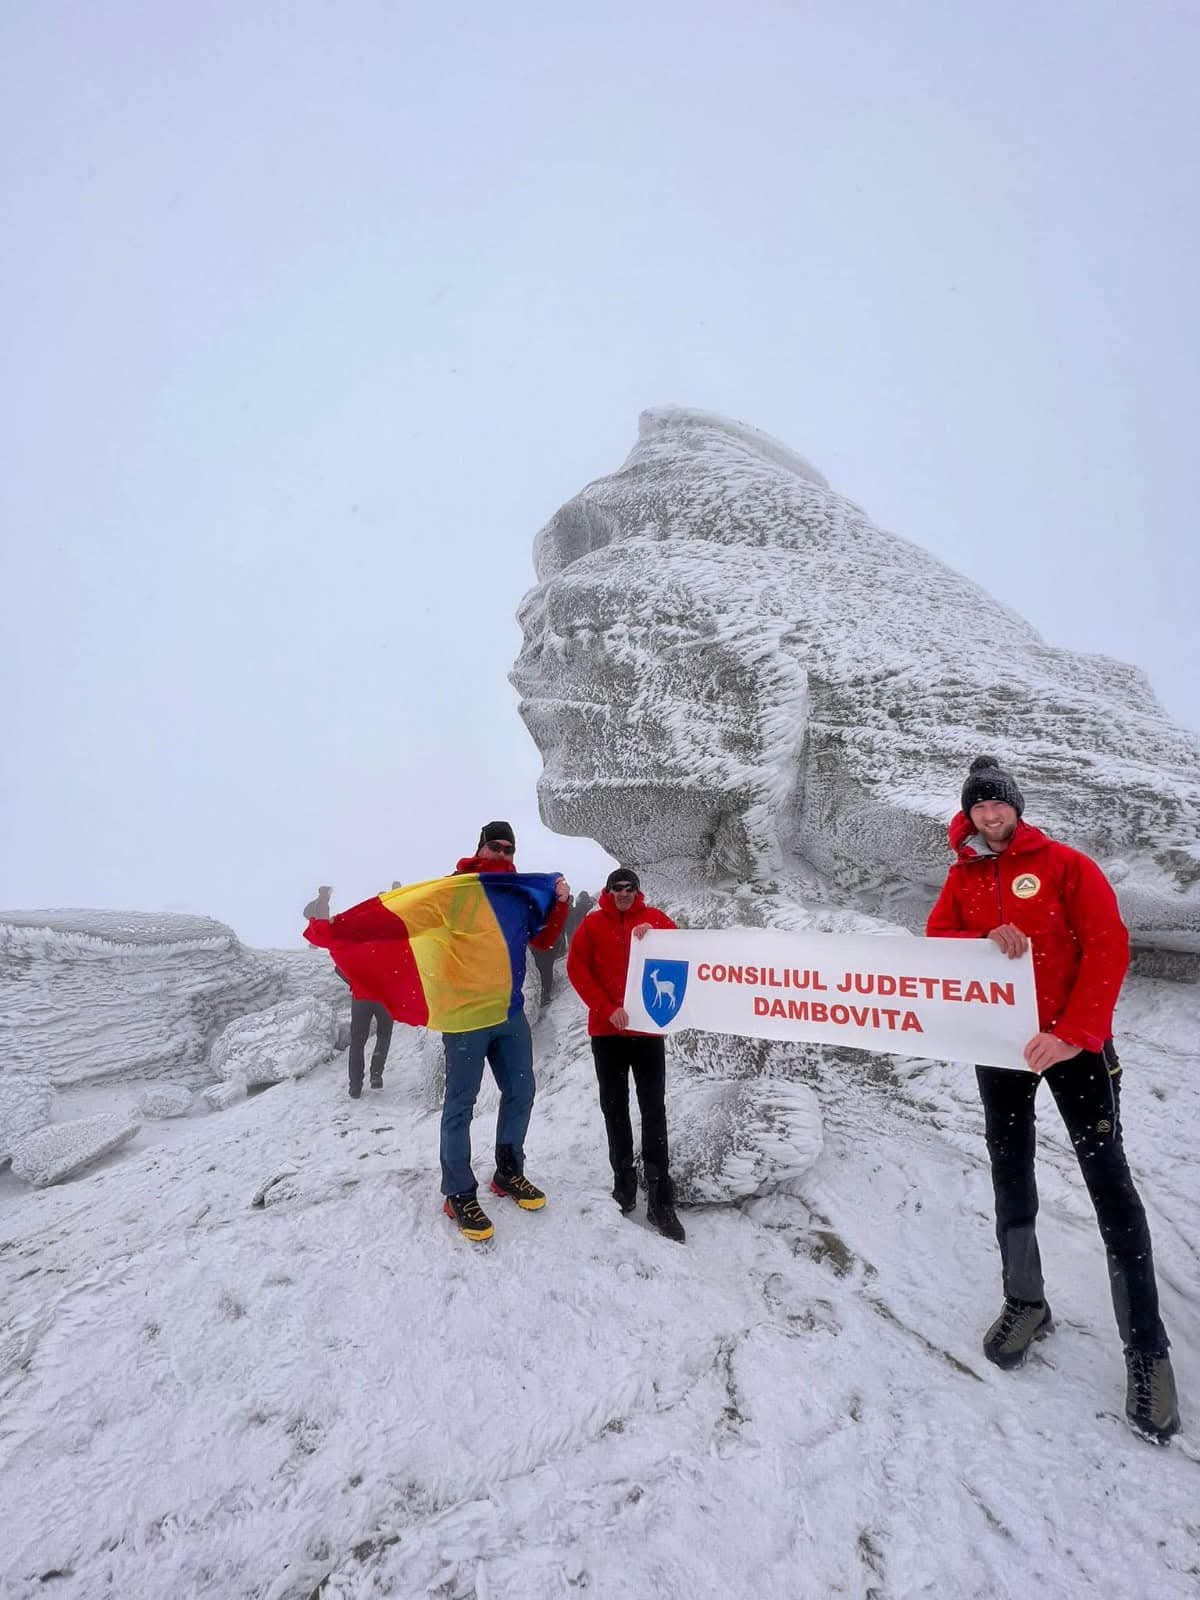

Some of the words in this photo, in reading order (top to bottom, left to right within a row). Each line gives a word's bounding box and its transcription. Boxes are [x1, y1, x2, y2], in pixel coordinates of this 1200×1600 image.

[698, 963, 827, 991] CONSILIUL
[837, 973, 1015, 1006] JUDETEAN
[754, 997, 923, 1033] DAMBOVITA
